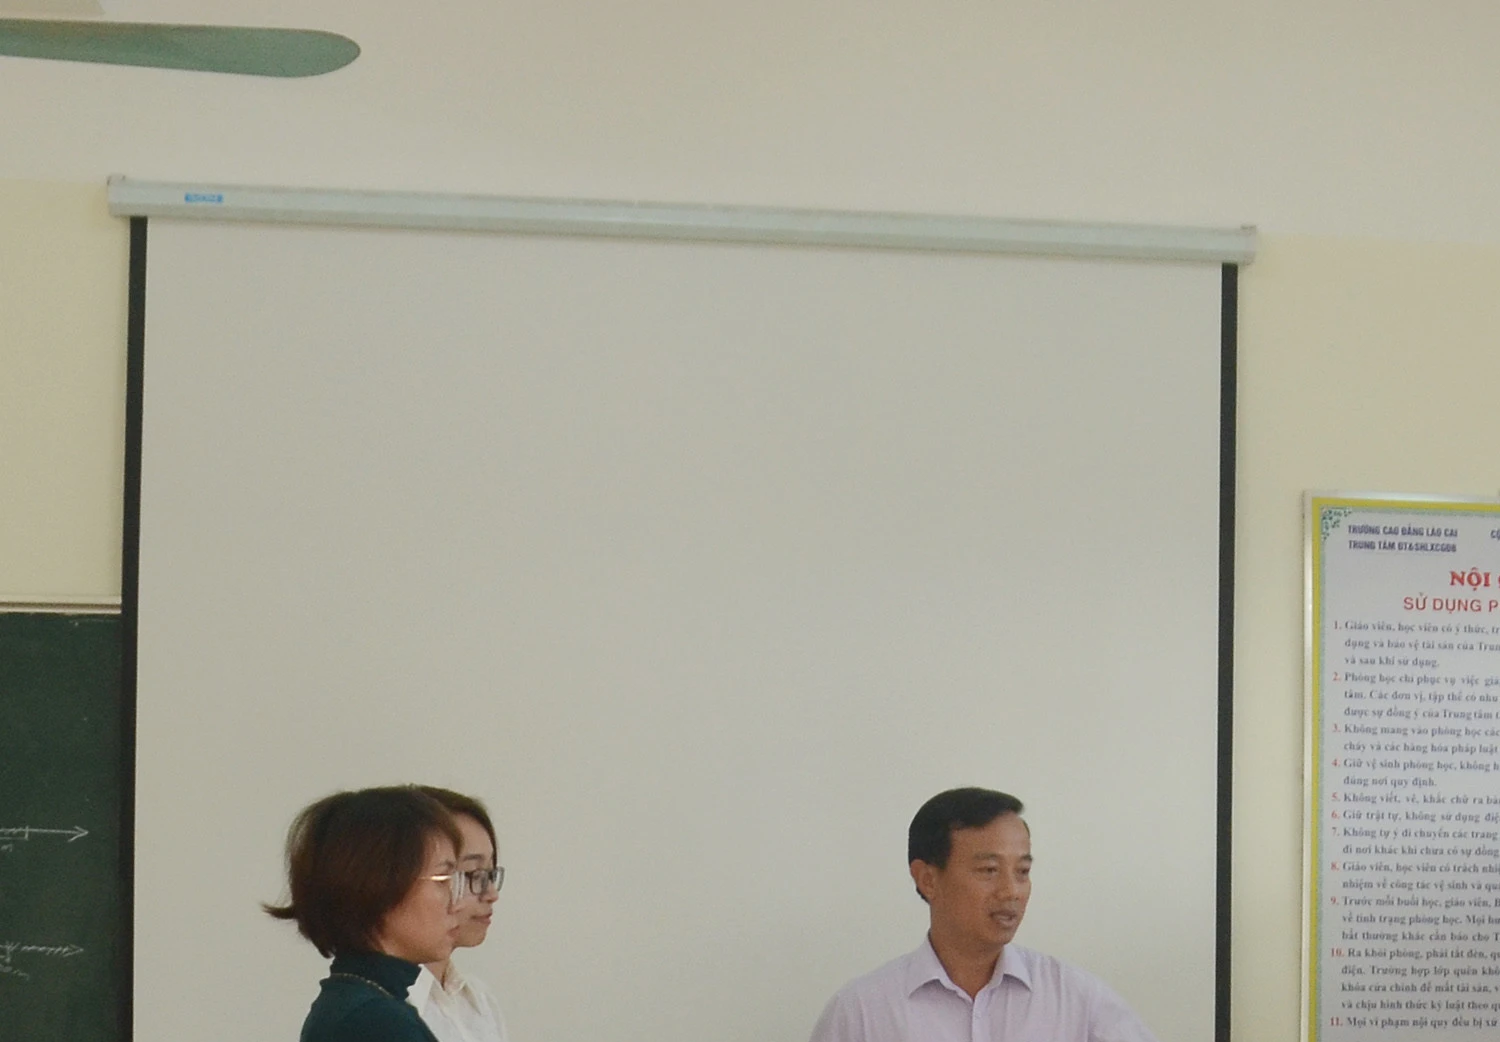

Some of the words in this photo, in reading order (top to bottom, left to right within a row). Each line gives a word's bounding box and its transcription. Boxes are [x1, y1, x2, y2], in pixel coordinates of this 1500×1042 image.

[1348, 540, 1376, 551] TRUNG
[1378, 539, 1396, 551] TÂM
[1449, 566, 1491, 592] NỘI
[1403, 592, 1428, 612] SỬ
[1432, 597, 1482, 615] DỤNG
[1343, 827, 1377, 839] Không
[1379, 829, 1391, 839] tự
[1471, 831, 1498, 841] trang
[1355, 845, 1372, 854] nơi
[1401, 845, 1418, 855] khi
[1420, 846, 1444, 855] chưa
[1460, 849, 1473, 858] sự
[1396, 863, 1413, 874] học
[1416, 862, 1437, 872] viên
[1342, 879, 1374, 891] nhiệm
[1389, 880, 1414, 891] công
[1433, 880, 1445, 892] vệ
[1447, 881, 1468, 890] sinh
[1379, 915, 1407, 926] trạng
[1465, 915, 1486, 926] Mọi
[1472, 932, 1490, 942] cho
[1347, 948, 1362, 957] Ra
[1411, 966, 1431, 978] hợp
[1453, 966, 1478, 978] quên
[1355, 1000, 1377, 1012] chịu
[1445, 1000, 1465, 1012] luật
[1467, 1001, 1489, 1010] theo
[1346, 1017, 1367, 1028] Mọi
[1380, 1017, 1410, 1029] phạm
[1412, 1017, 1428, 1029] nội
[1430, 1020, 1448, 1029] quy
